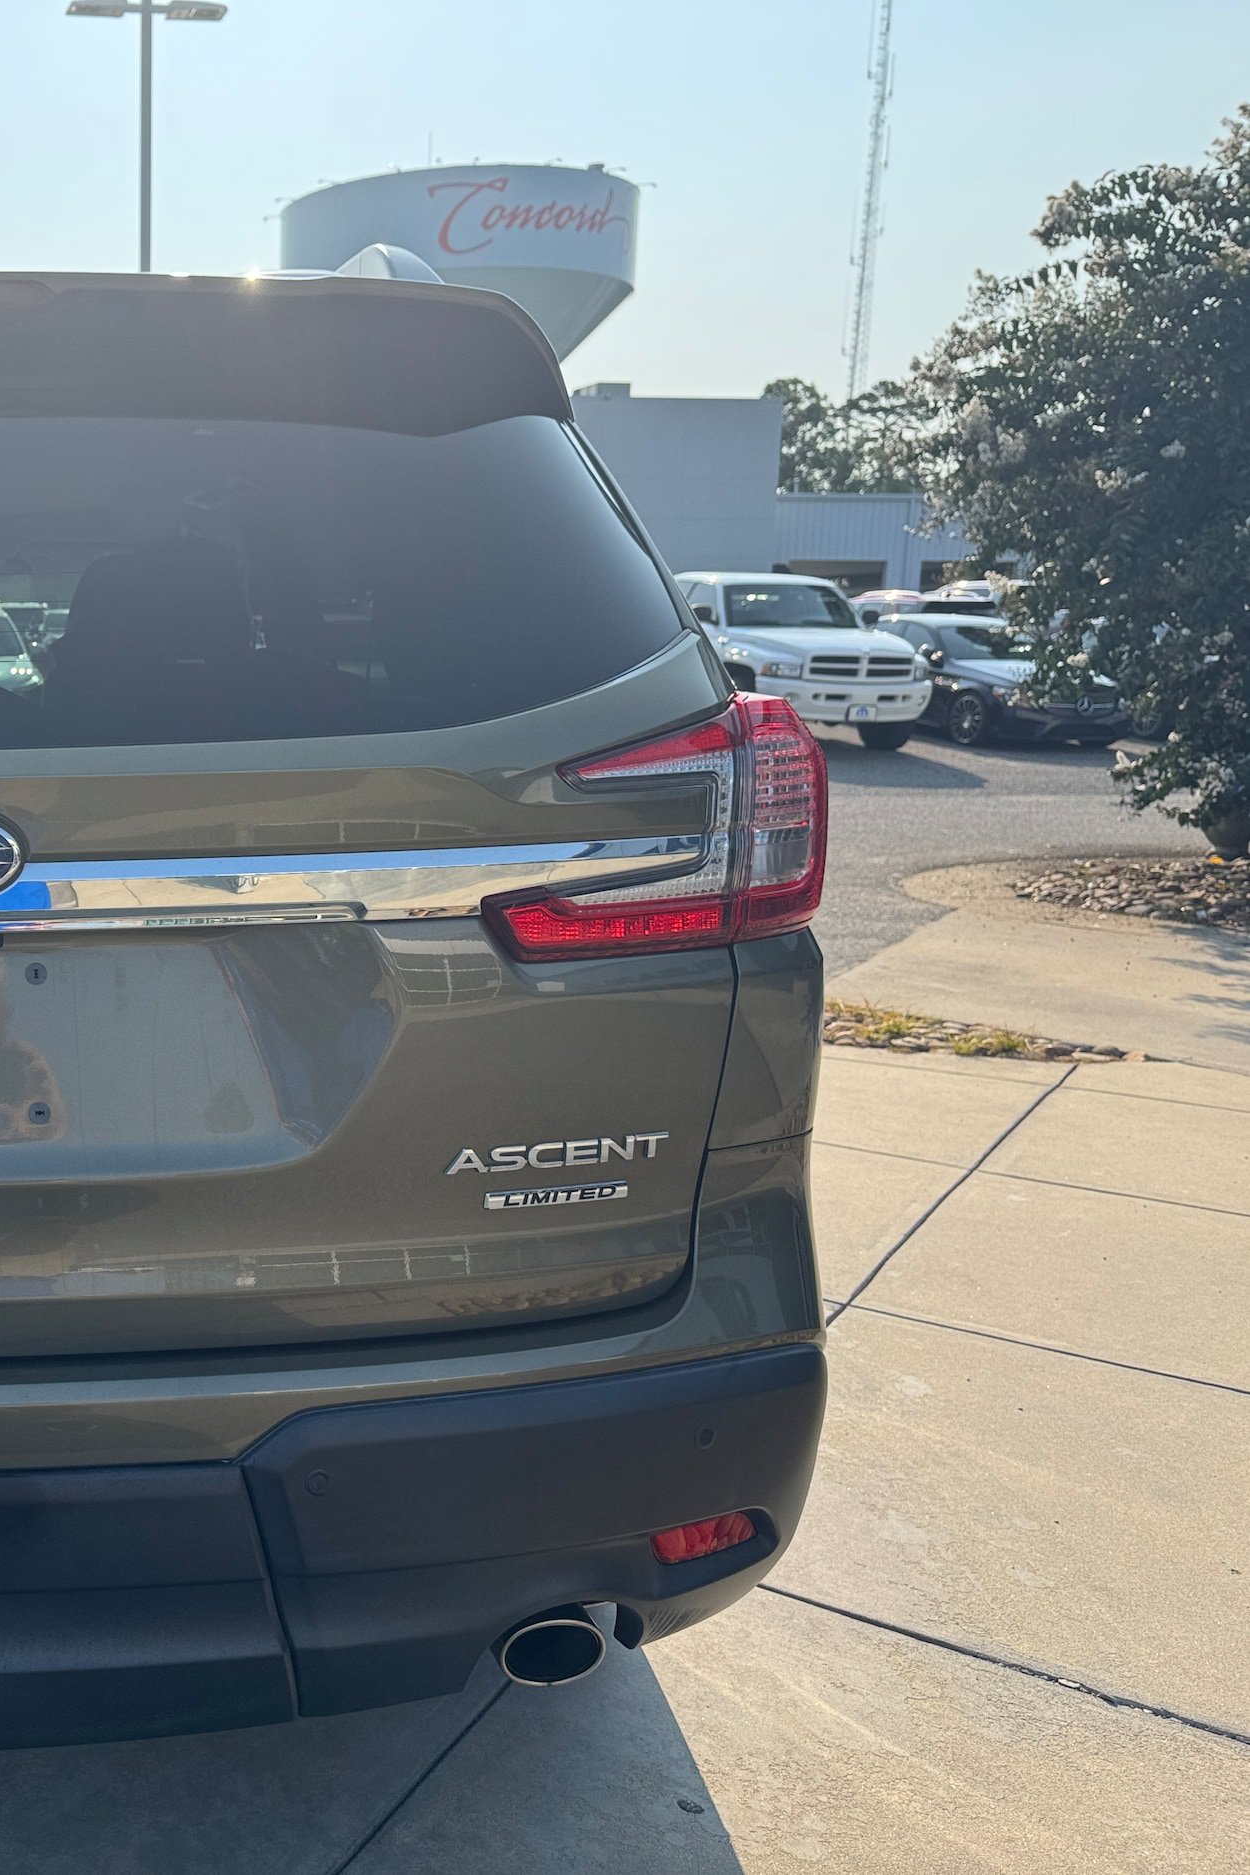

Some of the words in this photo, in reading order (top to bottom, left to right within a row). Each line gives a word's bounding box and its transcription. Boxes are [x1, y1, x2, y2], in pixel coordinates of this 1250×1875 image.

[426, 177, 629, 255] Concord
[445, 1131, 669, 1175] ASCENT
[503, 1185, 617, 1207] LIMITED
